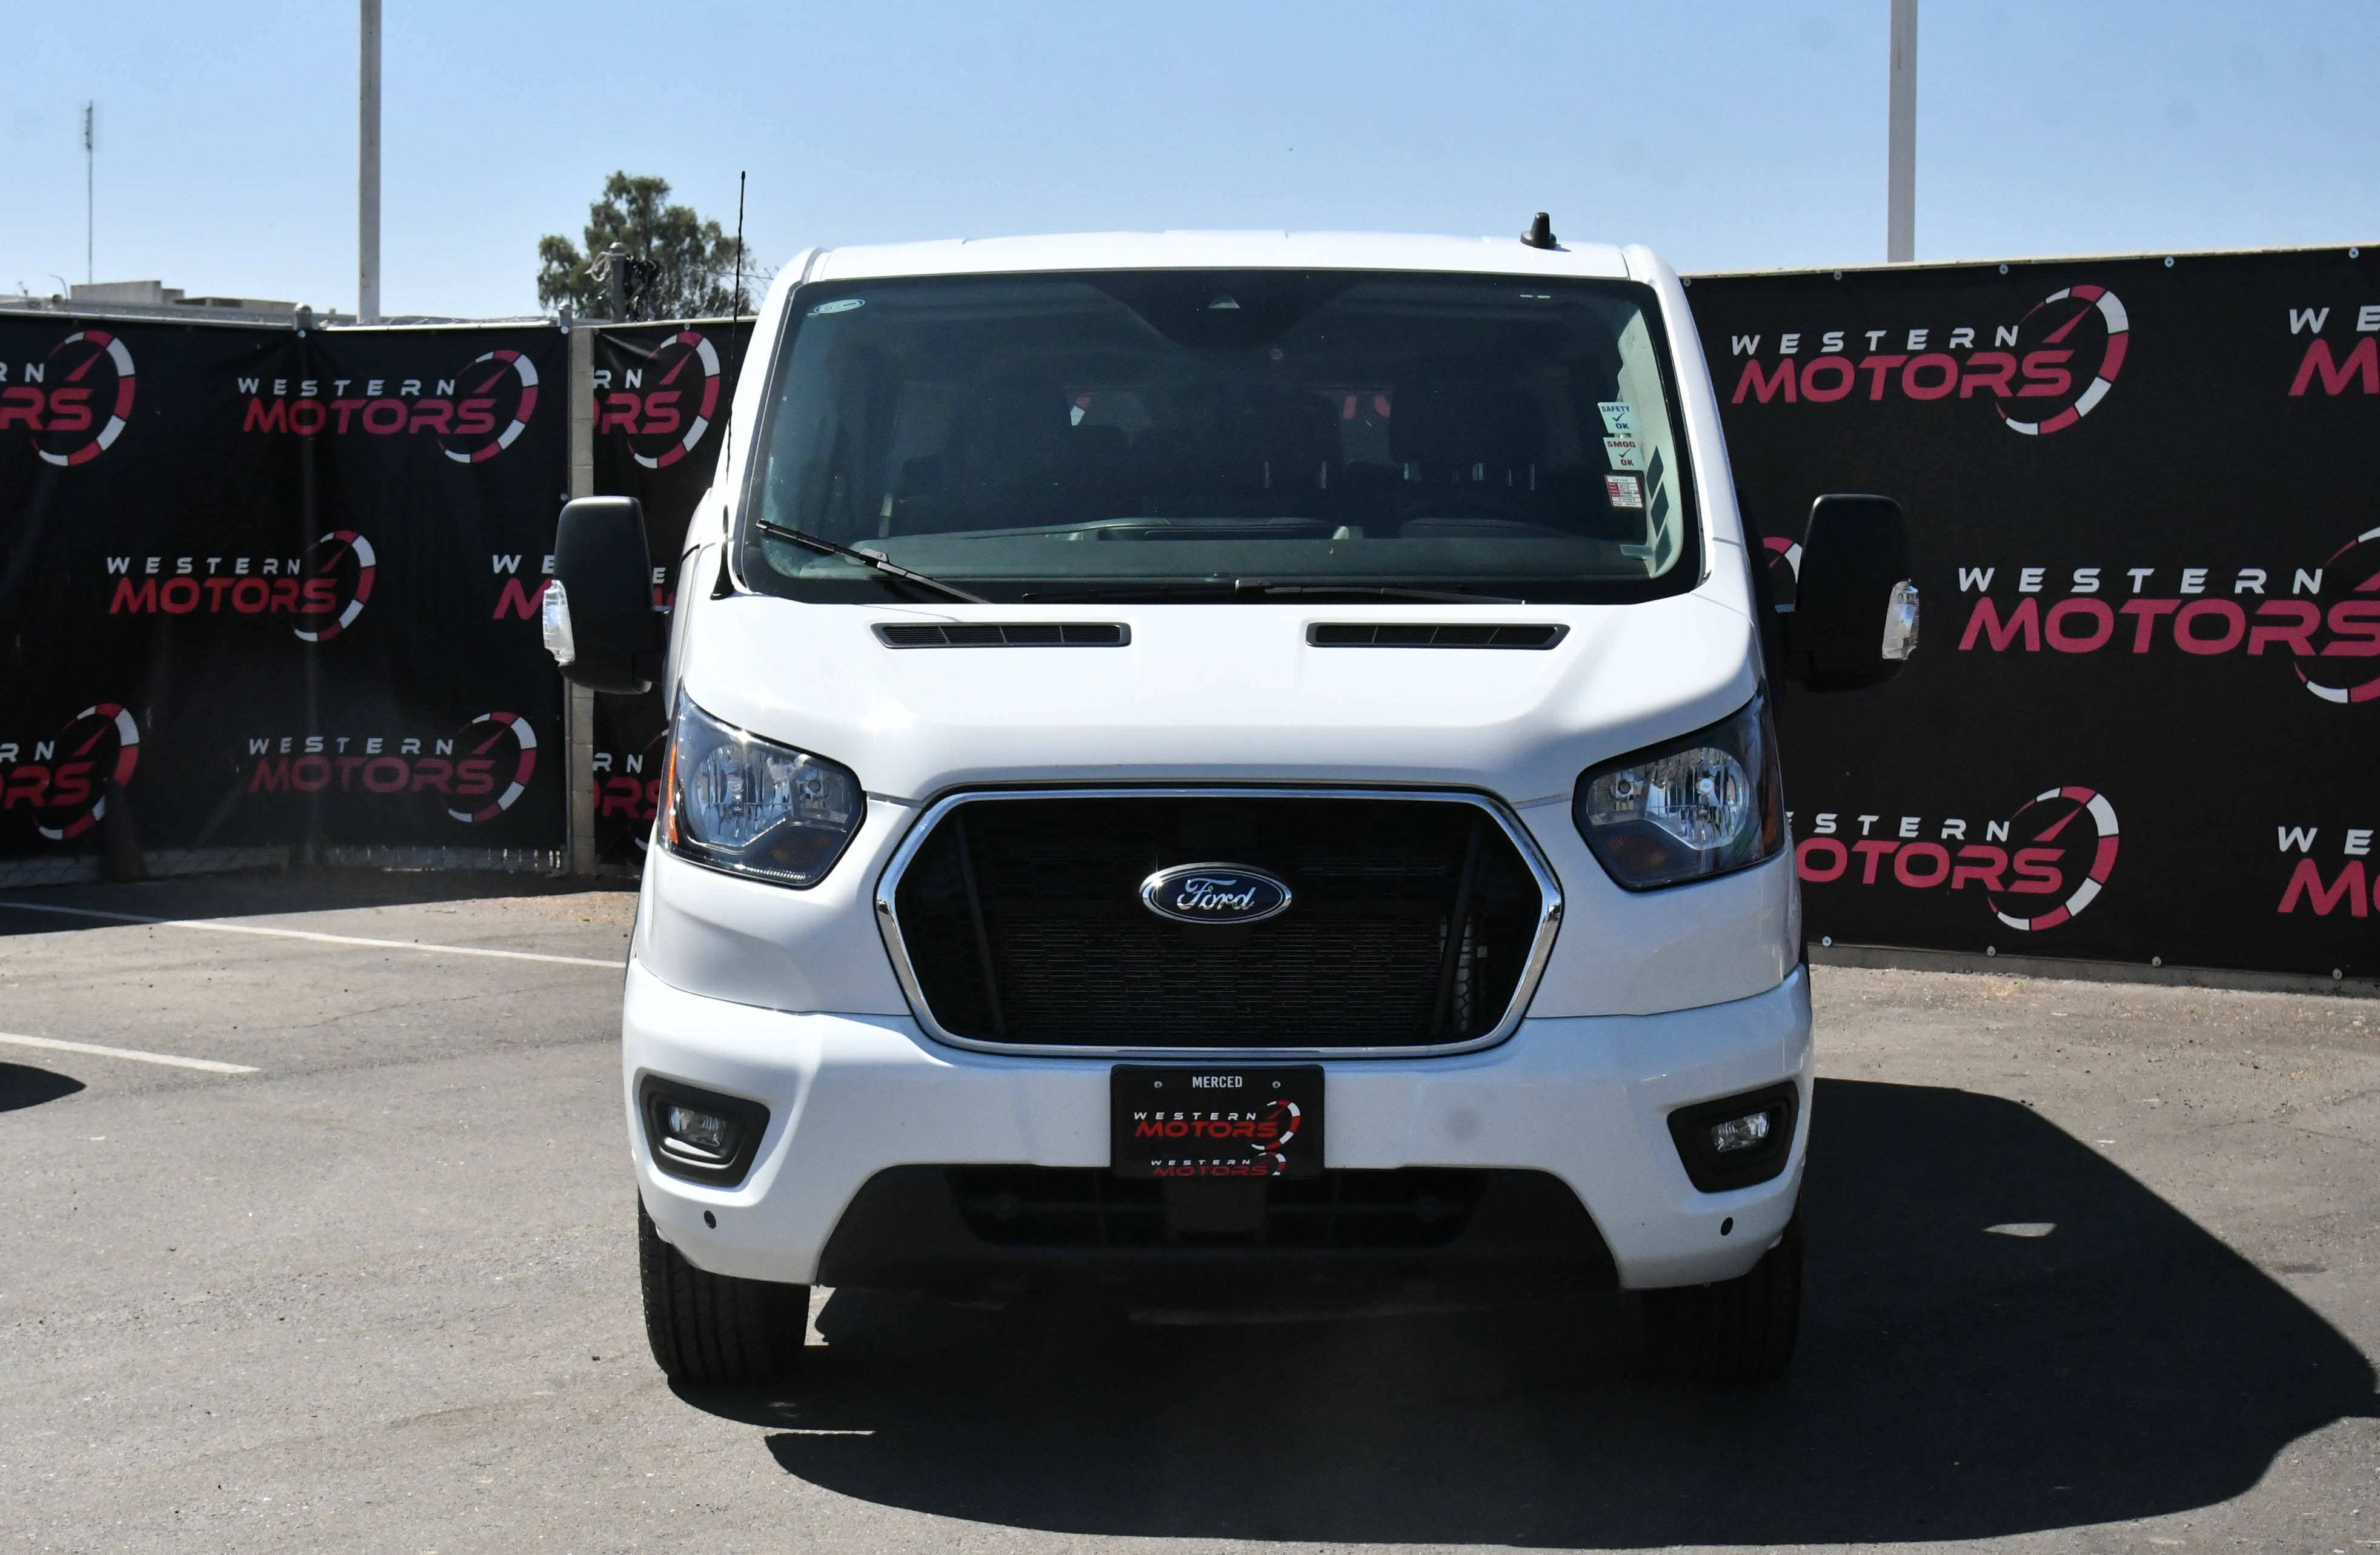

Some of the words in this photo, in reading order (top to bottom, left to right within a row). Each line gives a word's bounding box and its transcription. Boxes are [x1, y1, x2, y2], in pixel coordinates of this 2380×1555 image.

[1732, 325, 2018, 356] WESTERN
[239, 378, 454, 396] WESTERN
[1732, 350, 2074, 404] MOTORS
[243, 397, 496, 435] MOTORS
[593, 391, 681, 434] RS
[107, 557, 300, 574] WESTERN
[1958, 567, 2323, 595] WESTERN
[109, 577, 337, 614] MOTORS
[1958, 597, 2380, 656] MOTORS
[250, 737, 453, 755] WESTERN
[0, 761, 93, 809] RS
[249, 756, 496, 794] MOTORS
[1786, 811, 2010, 843] STERN
[1177, 878, 1257, 909] Ford
[1192, 1076, 1243, 1088] MERCED
[1134, 1112, 1256, 1121] WESTERN
[1135, 1120, 1278, 1138] MOTORS
[1153, 1164, 1269, 1177] MOTORS
